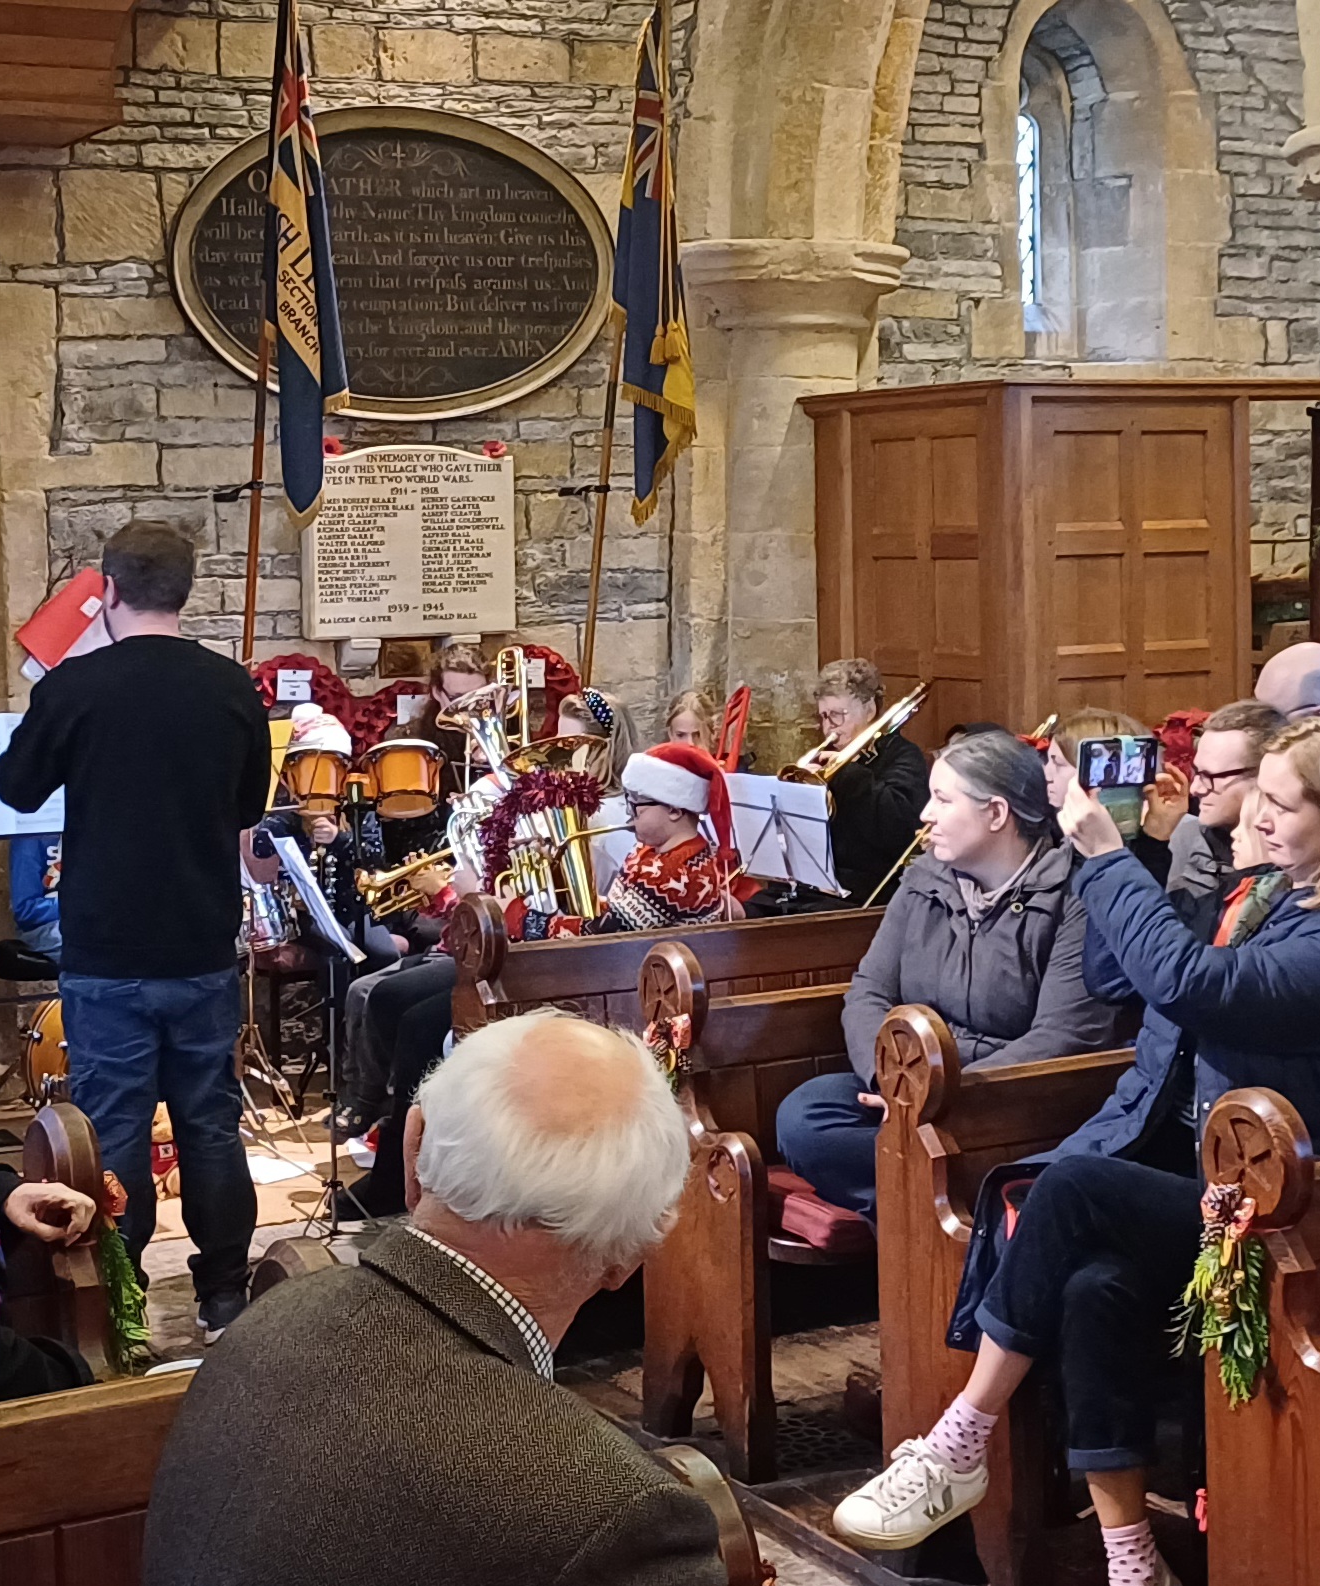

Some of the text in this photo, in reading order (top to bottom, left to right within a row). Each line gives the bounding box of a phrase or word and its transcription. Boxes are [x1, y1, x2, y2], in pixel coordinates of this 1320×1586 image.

[329, 178, 402, 196] ATHER
[412, 180, 453, 199] which
[487, 185, 501, 199] in
[452, 204, 516, 230] kingdom
[204, 223, 229, 239] will
[238, 223, 256, 240] be
[500, 228, 533, 246] Give
[560, 229, 586, 247] this
[368, 250, 402, 266] And
[409, 249, 460, 273] forgive
[466, 254, 483, 267] us
[487, 255, 514, 268] our
[369, 271, 400, 288] that
[212, 294, 248, 310] lead
[446, 294, 475, 312] But
[279, 300, 319, 355] BRANCH
[498, 317, 521, 334] the
[366, 454, 378, 462] IN
[379, 454, 421, 462] MEMORY
[338, 466, 350, 474] OF
[353, 465, 375, 473] THIS
[377, 465, 418, 473] VILLAGE
[420, 464, 443, 472] WHO
[445, 464, 471, 472] GAVE
[474, 463, 502, 472] THEIR
[345, 476, 355, 484] IN
[358, 476, 378, 485] THE
[379, 476, 402, 484] TWO
[405, 475, 440, 483] WORLD
[388, 603, 444, 613] 1939 1945
